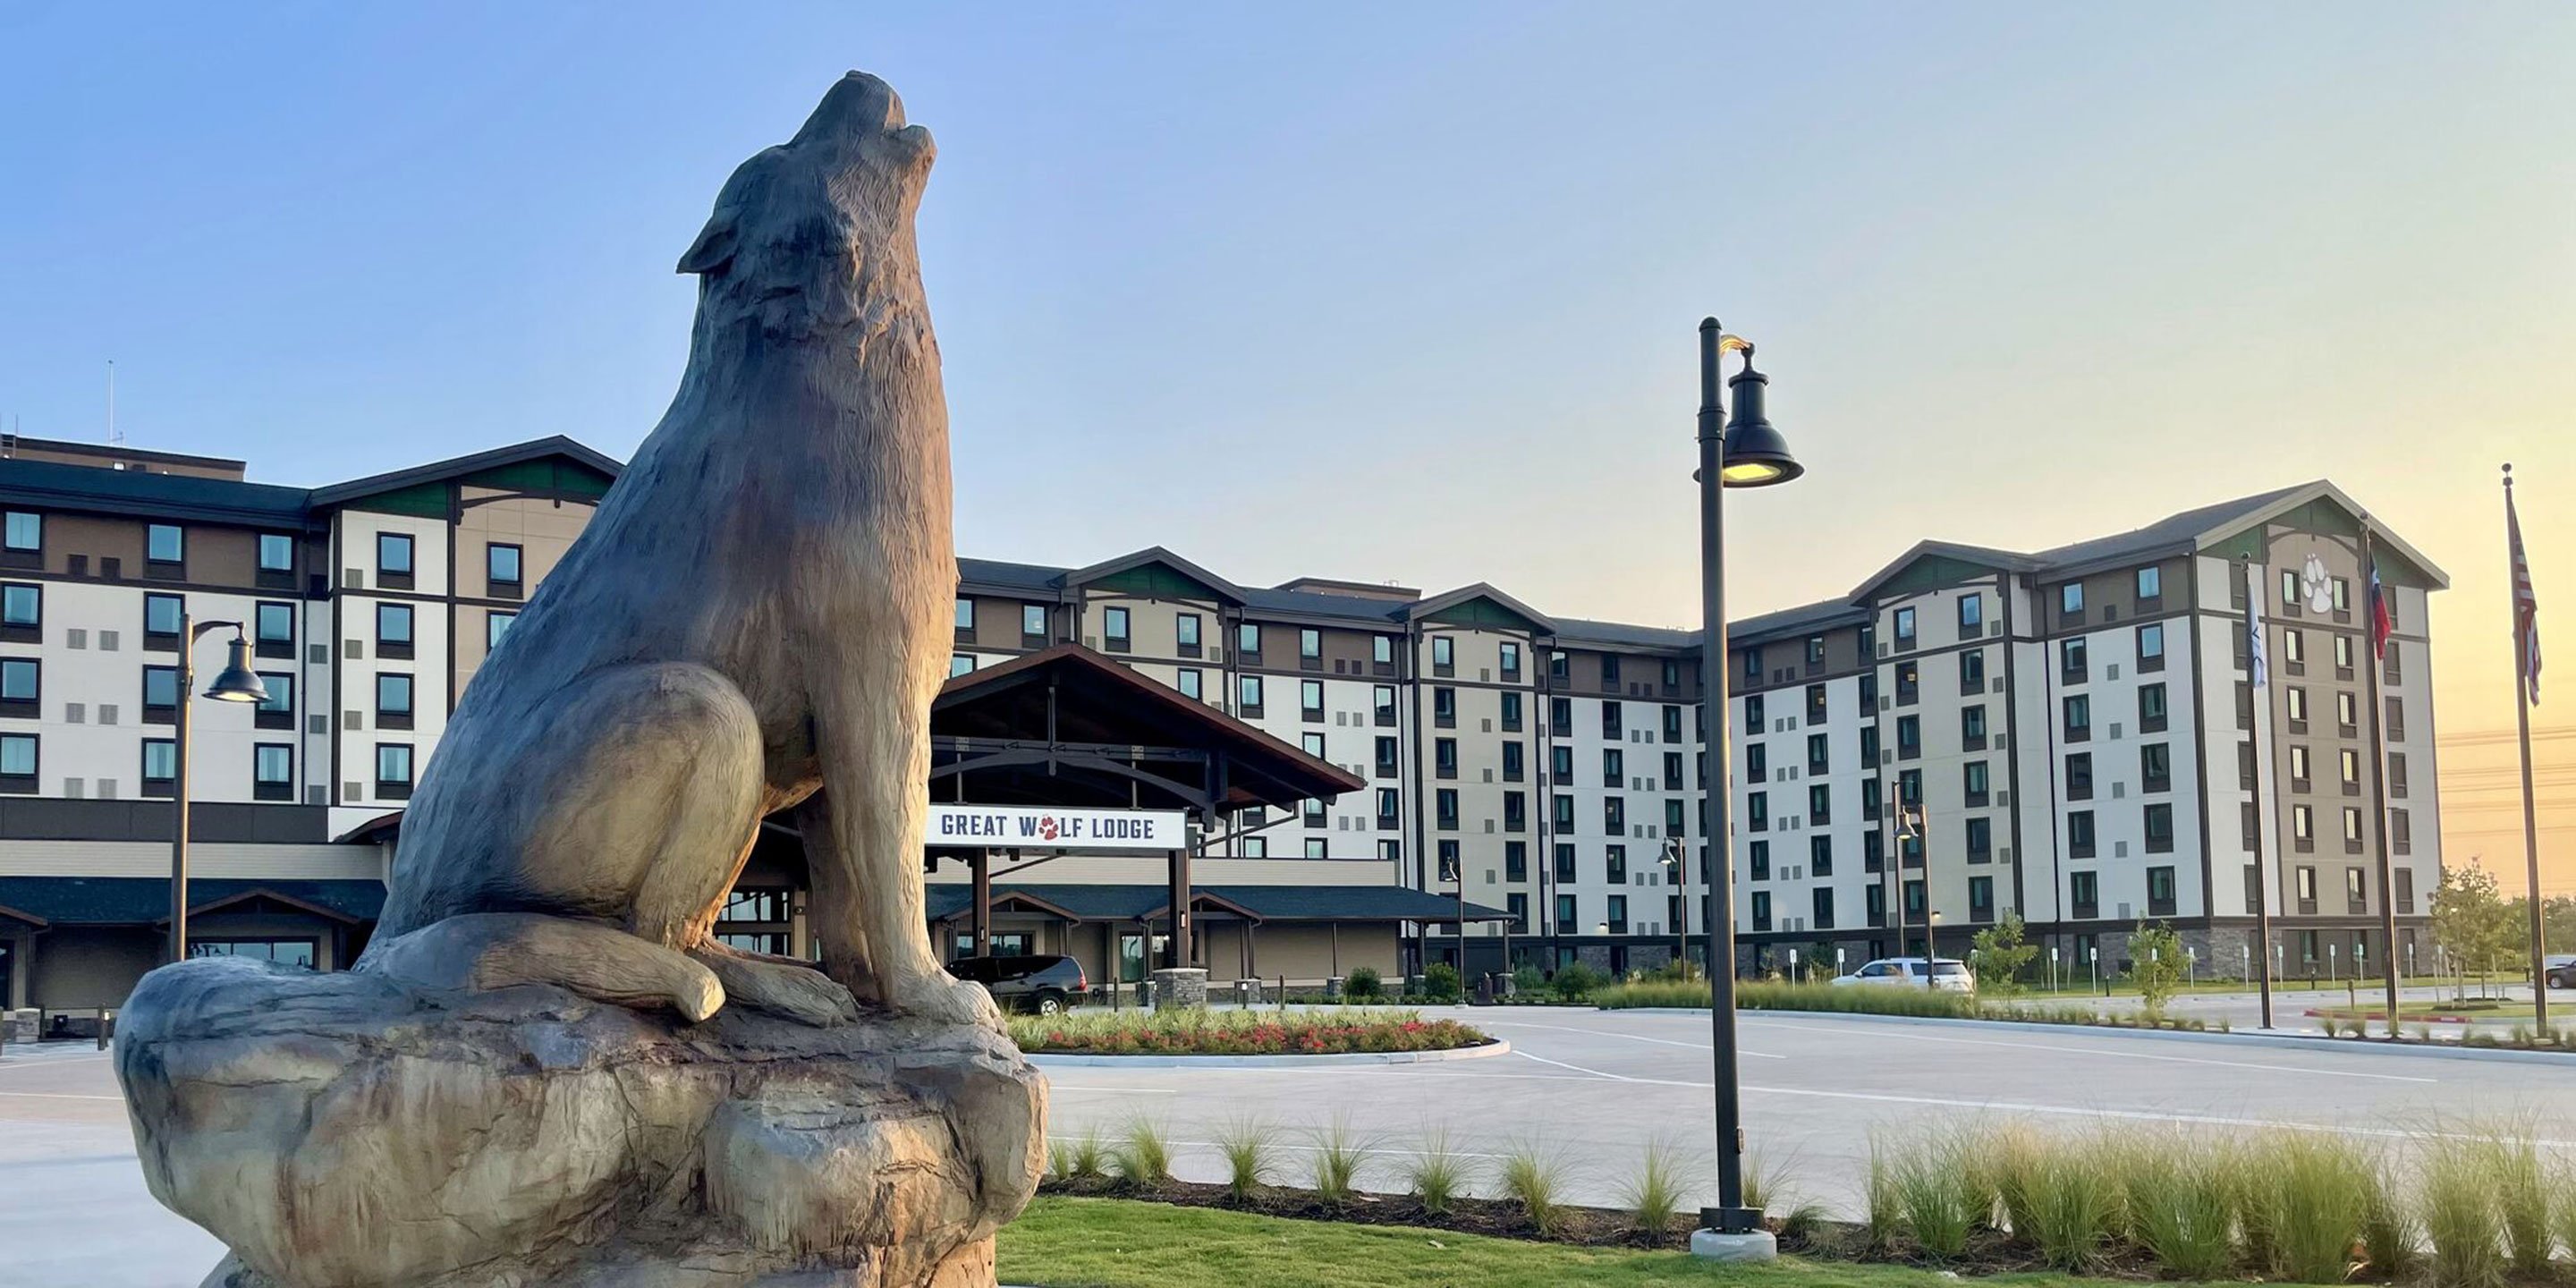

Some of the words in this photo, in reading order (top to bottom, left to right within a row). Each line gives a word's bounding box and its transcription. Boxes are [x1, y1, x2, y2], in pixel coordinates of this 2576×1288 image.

[942, 814, 1007, 835] GREAT
[1018, 816, 1083, 839] WLF
[1092, 818, 1154, 839] LODGE
